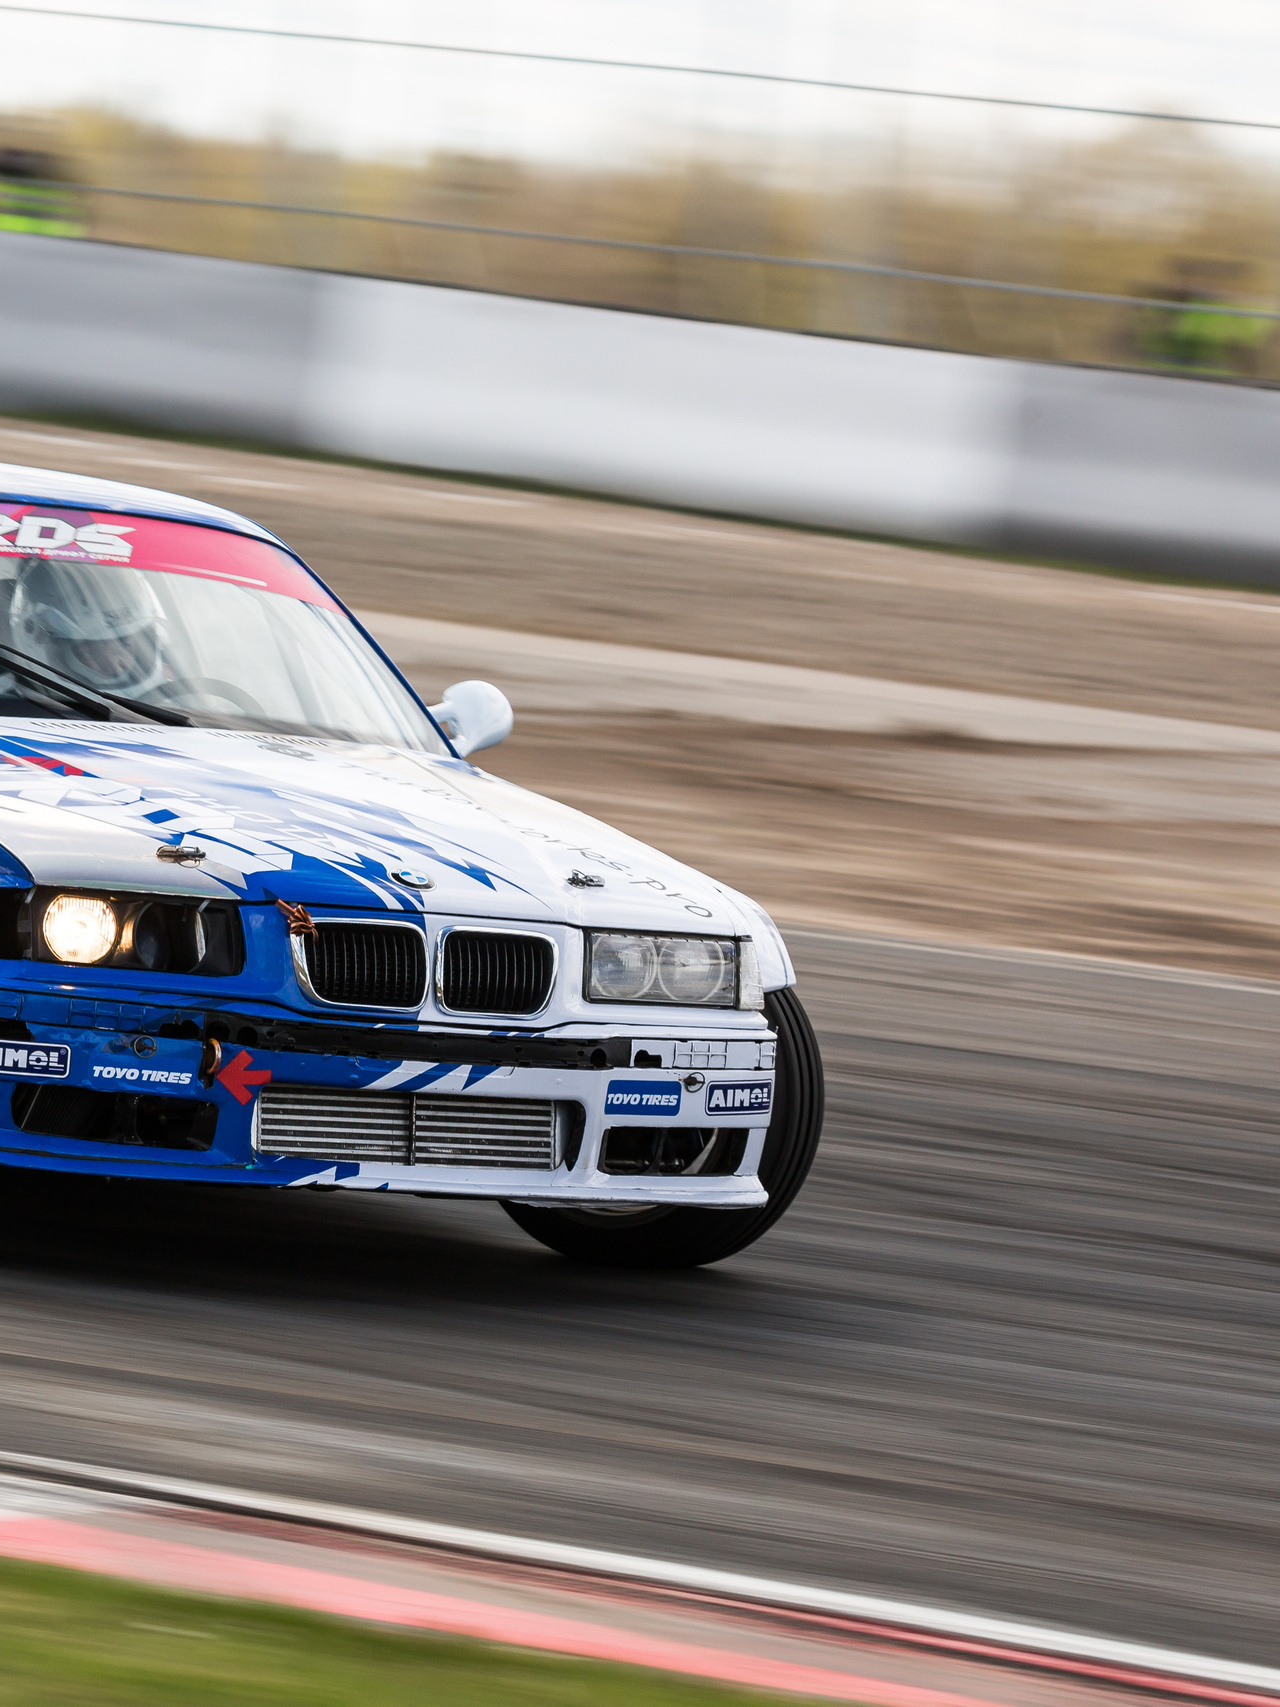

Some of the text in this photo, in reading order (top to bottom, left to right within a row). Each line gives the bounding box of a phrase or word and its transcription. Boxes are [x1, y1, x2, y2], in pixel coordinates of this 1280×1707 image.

[93, 1066, 192, 1084] TOYO TIRES
[607, 1093, 678, 1106] TOYO TIRES
[709, 1088, 769, 1108] AIMOL
